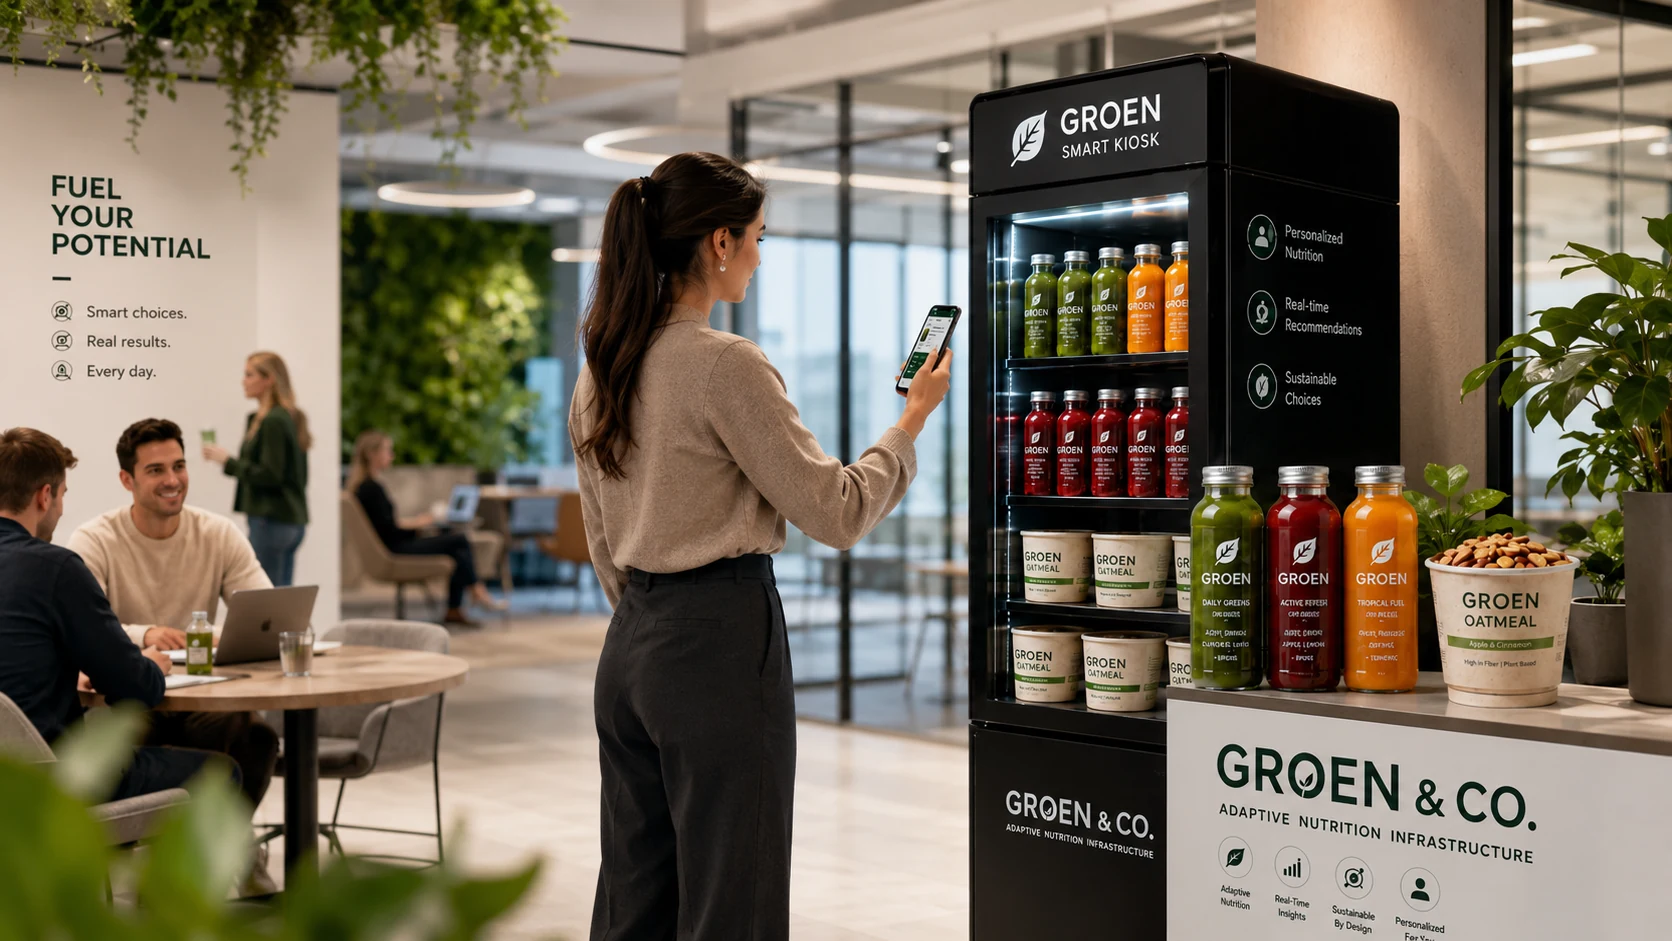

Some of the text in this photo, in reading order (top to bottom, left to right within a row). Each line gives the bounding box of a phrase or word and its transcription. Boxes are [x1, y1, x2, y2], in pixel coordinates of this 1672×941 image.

[1060, 93, 1161, 136] GROEN
[1062, 132, 1160, 159] SMART KIOSK
[51, 175, 122, 200] FUEL
[51, 204, 133, 229] YOUR
[1285, 225, 1343, 245] Personalized
[52, 233, 211, 259] POTENTIAL
[1285, 246, 1324, 262] Nutrition
[1057, 305, 1084, 316] GROEN
[1092, 303, 1118, 313] GROEN
[1128, 301, 1155, 311] GROEN
[1165, 299, 1189, 309] GROE
[1285, 297, 1329, 313] Real-time
[86, 305, 188, 319] Smart choices.
[1285, 318, 1363, 336] Recommendations
[86, 335, 171, 348] Real results.
[86, 364, 157, 380] Every day.
[1285, 370, 1337, 386] Sustainable
[1285, 392, 1322, 406] Choices
[1024, 446, 1049, 454] GROEN
[1057, 446, 1083, 454] GROEN
[1092, 445, 1118, 454] GROEN
[1128, 445, 1156, 453] GROEN
[1165, 445, 1189, 453] GROE
[1024, 551, 1061, 563] GROEN
[1096, 554, 1136, 566] GROEN
[1026, 563, 1060, 573] OATMEAL
[1098, 567, 1135, 576] OATMEAL
[1201, 572, 1251, 585] GROEN
[1278, 572, 1329, 585] GROEN
[1356, 572, 1407, 585] GROEN
[1202, 599, 1221, 607] DAILY
[1280, 599, 1304, 607] ACTIVE
[1357, 599, 1388, 607] TROPICAL
[1462, 592, 1539, 610] GROEN
[1464, 614, 1537, 628] OATMEAL
[1014, 649, 1052, 661] GROEN
[1016, 662, 1051, 672] OATMEAL
[1086, 656, 1126, 669] GROEN
[1170, 662, 1191, 675] GRO
[1087, 669, 1124, 679] OATMEAL
[1217, 743, 1537, 832] GROEN & CO.
[1005, 789, 1154, 841] GROEN & CO.
[1219, 803, 1534, 864] ADAPTIVE NUTRITION INFRASTRUCTURE
[1005, 823, 1154, 859] ADAPTIVE NUTRITION INFRASTRUCTURE
[1220, 884, 1251, 897] Adaptive
[1220, 897, 1250, 910] Nutrition
[1275, 894, 1310, 908] Real-Time
[1278, 908, 1306, 921] Insights
[1332, 905, 1376, 921] Sustainable
[1334, 918, 1373, 935] By Design
[1395, 916, 1445, 934] Personalized
